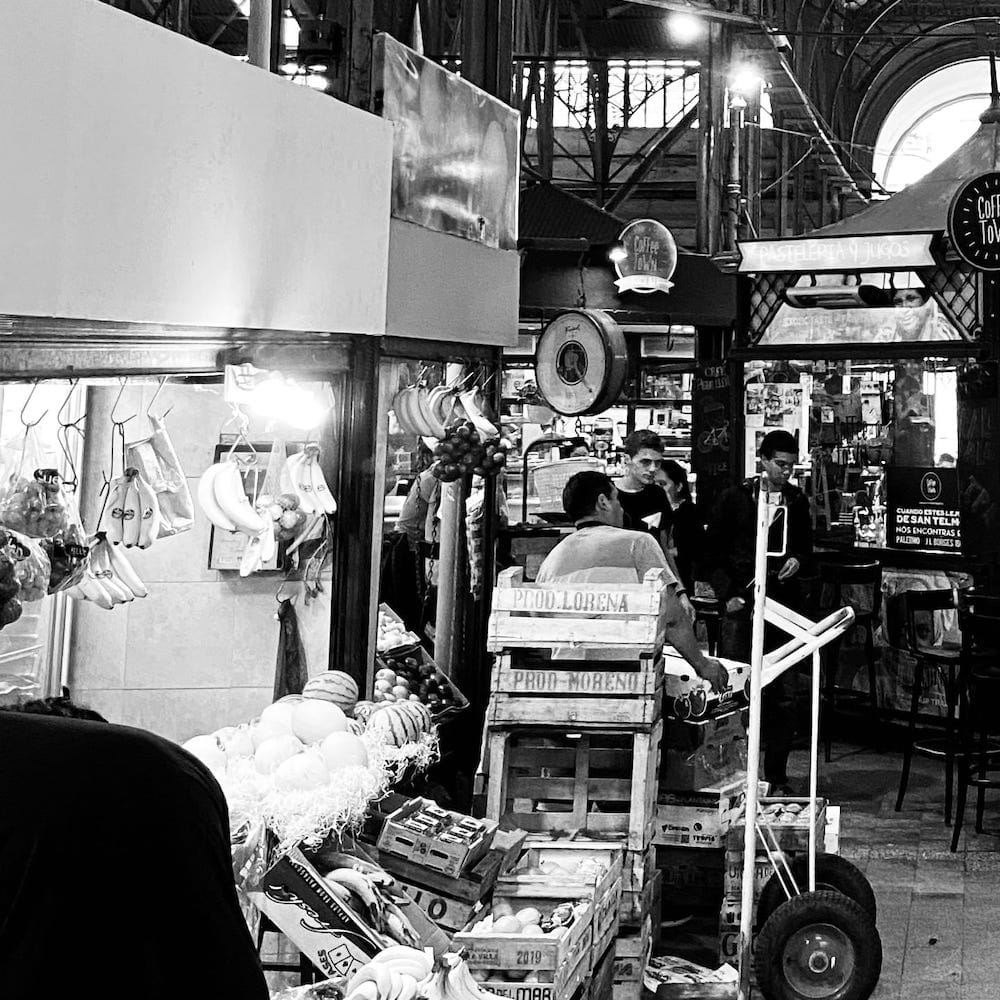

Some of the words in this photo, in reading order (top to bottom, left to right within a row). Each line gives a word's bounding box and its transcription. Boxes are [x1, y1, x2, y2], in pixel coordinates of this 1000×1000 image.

[897, 515, 910, 524] DE
[910, 516, 931, 525] SAN
[932, 517, 960, 526] TELM
[896, 526, 911, 534] NOS
[517, 950, 542, 965] 2019
